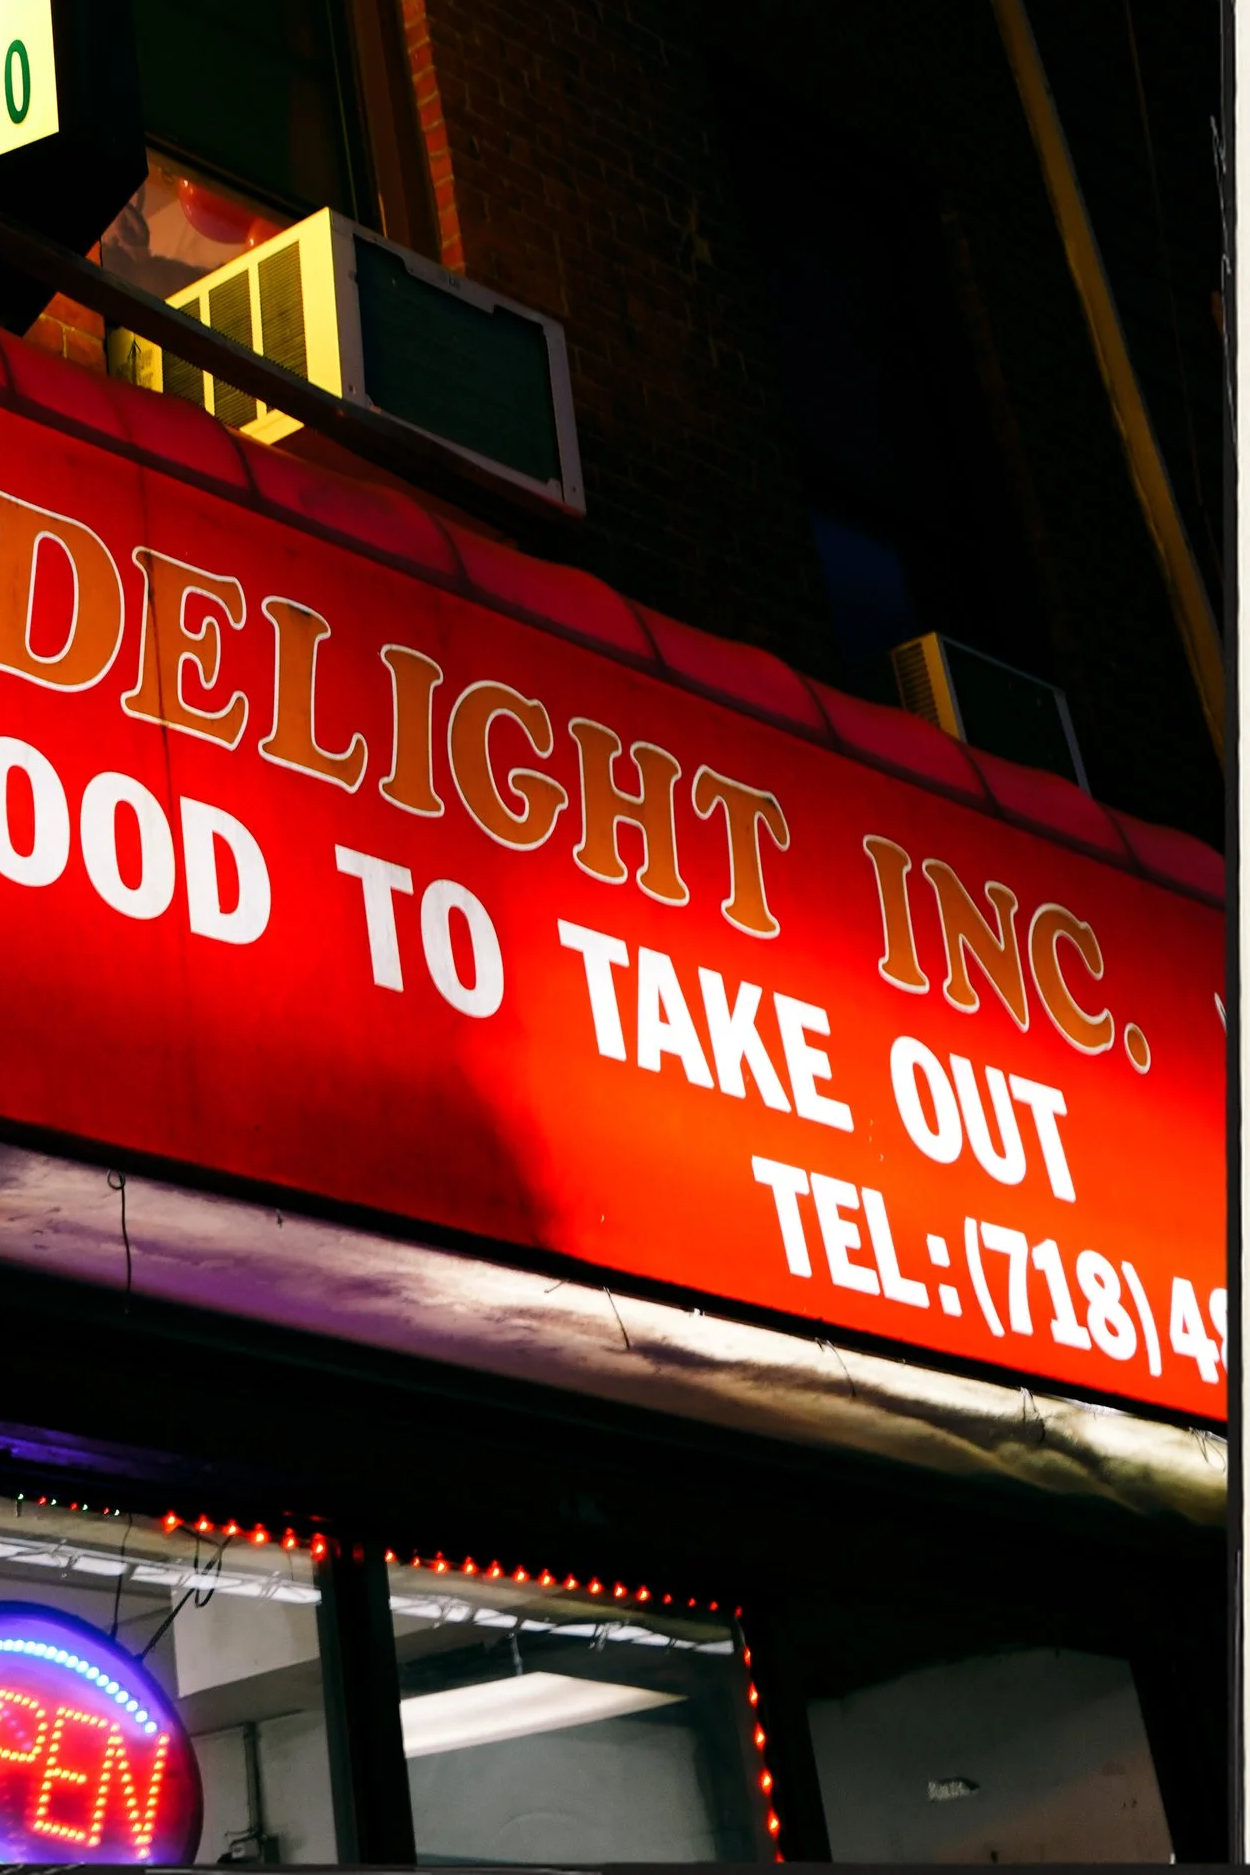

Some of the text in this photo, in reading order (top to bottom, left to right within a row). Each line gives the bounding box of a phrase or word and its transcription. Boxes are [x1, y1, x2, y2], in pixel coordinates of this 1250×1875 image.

[334, 844, 505, 1018] TO
[557, 918, 855, 1133] TAKE
[889, 1035, 1077, 1203] OUT
[863, 835, 1151, 1074] INC.
